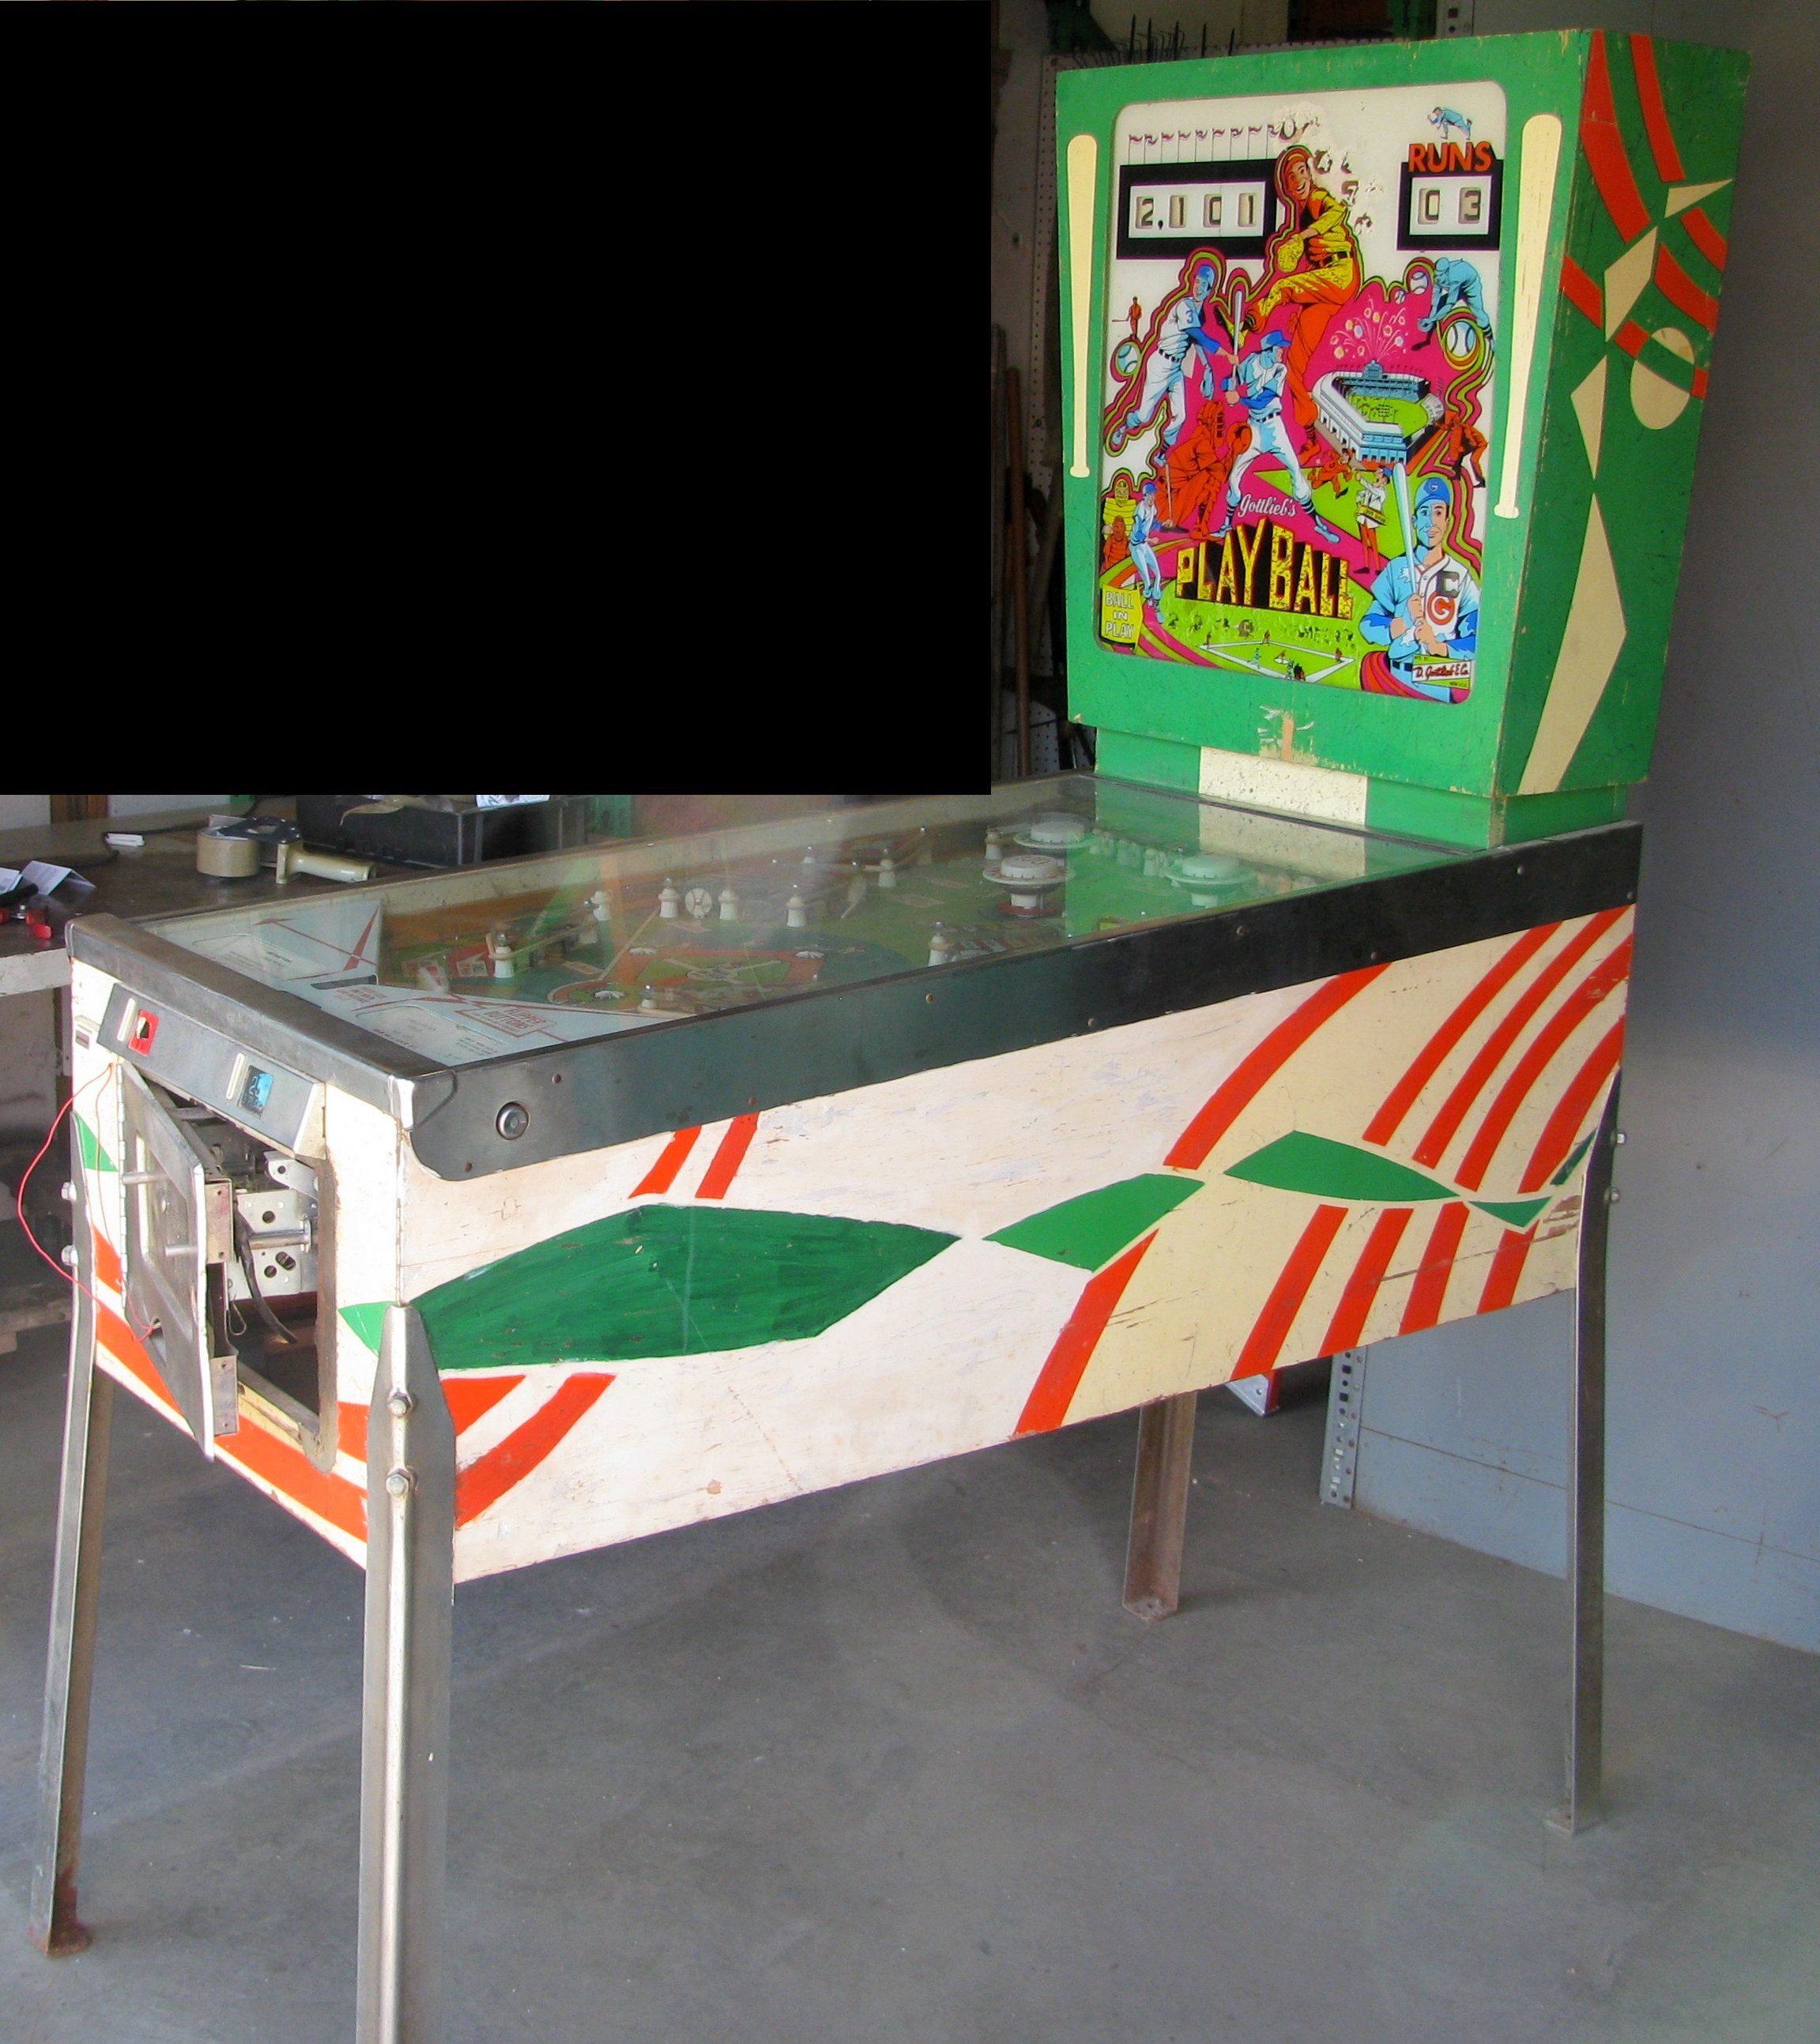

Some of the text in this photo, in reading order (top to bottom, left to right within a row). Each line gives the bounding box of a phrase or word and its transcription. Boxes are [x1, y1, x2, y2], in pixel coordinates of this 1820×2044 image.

[1408, 141, 1493, 172] RUNS
[1185, 310, 1193, 323] 3
[1238, 494, 1296, 517] Gottlieb's
[1176, 517, 1353, 619] PLAY BALL
[1106, 591, 1134, 609] BALL
[1113, 610, 1129, 621] IN
[1106, 621, 1134, 639] PLAY
